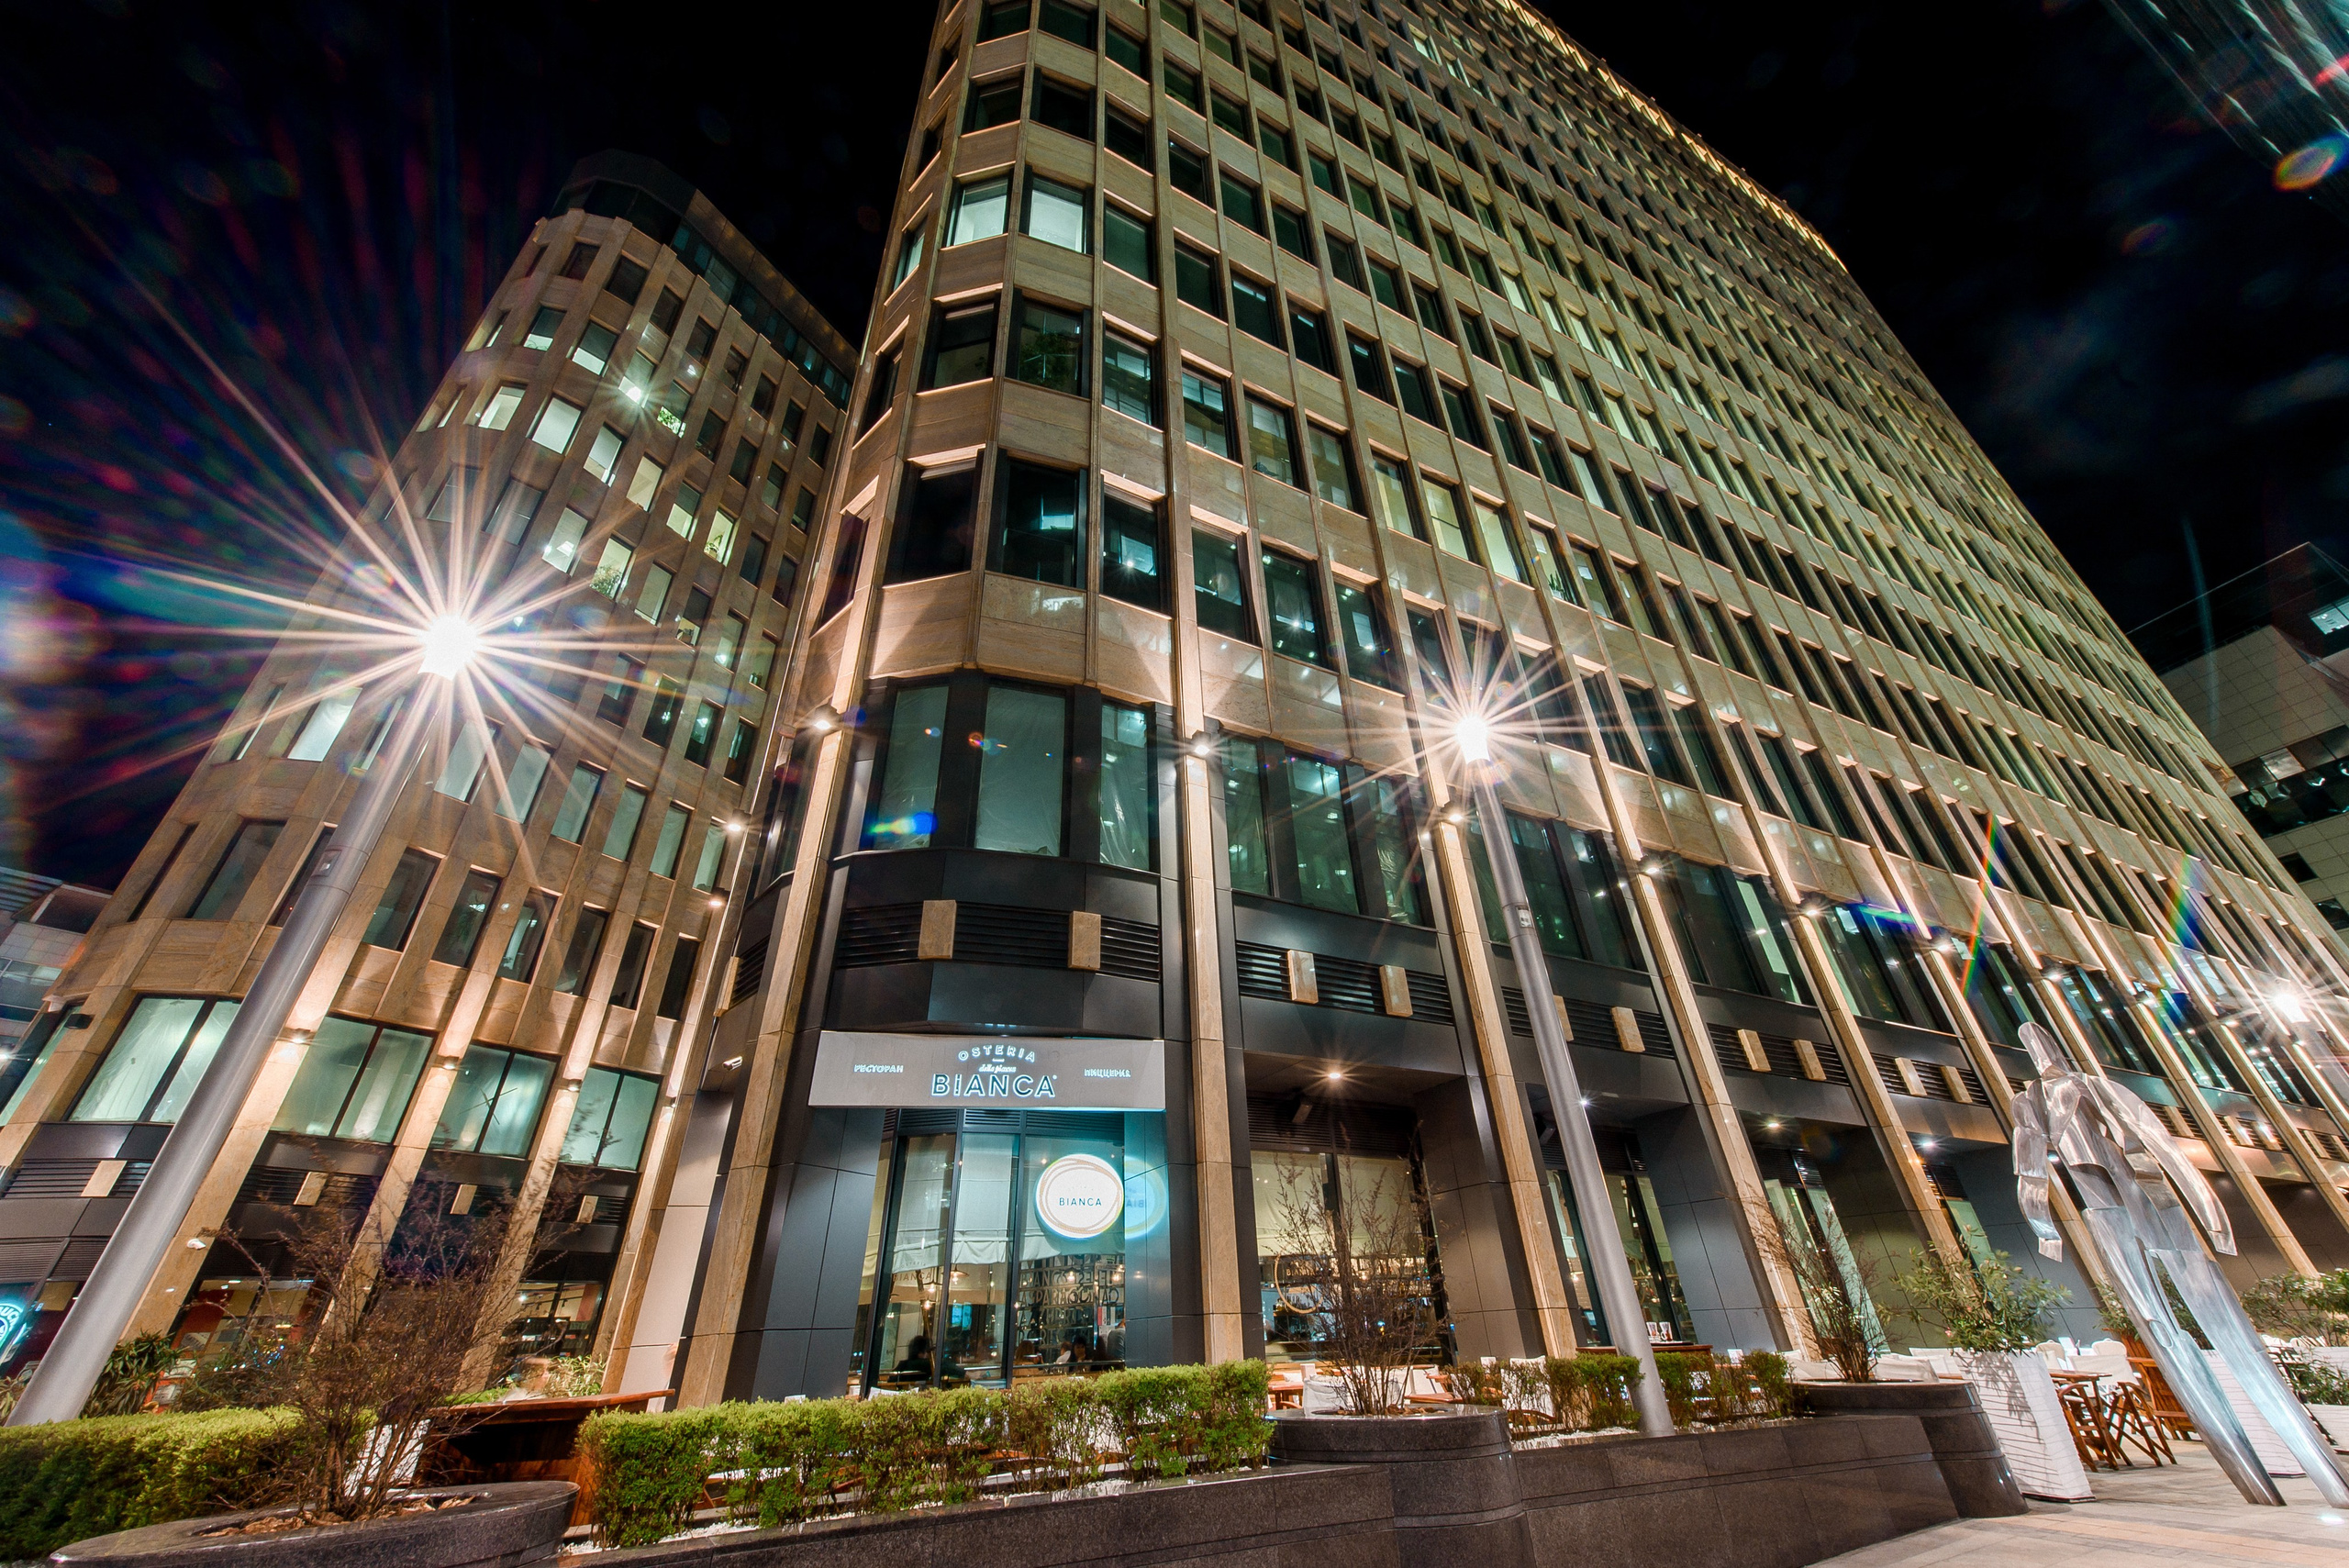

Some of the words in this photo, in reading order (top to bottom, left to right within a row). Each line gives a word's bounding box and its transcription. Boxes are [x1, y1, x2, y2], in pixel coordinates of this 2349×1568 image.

[958, 1044, 1035, 1062] OSTERIA
[853, 1064, 904, 1073] РЕСТОРАН
[1084, 1068, 1131, 1078] ПИЦЦЕРИЯ
[931, 1073, 1056, 1097] BIANCA
[1059, 1197, 1102, 1207] BIANCA
